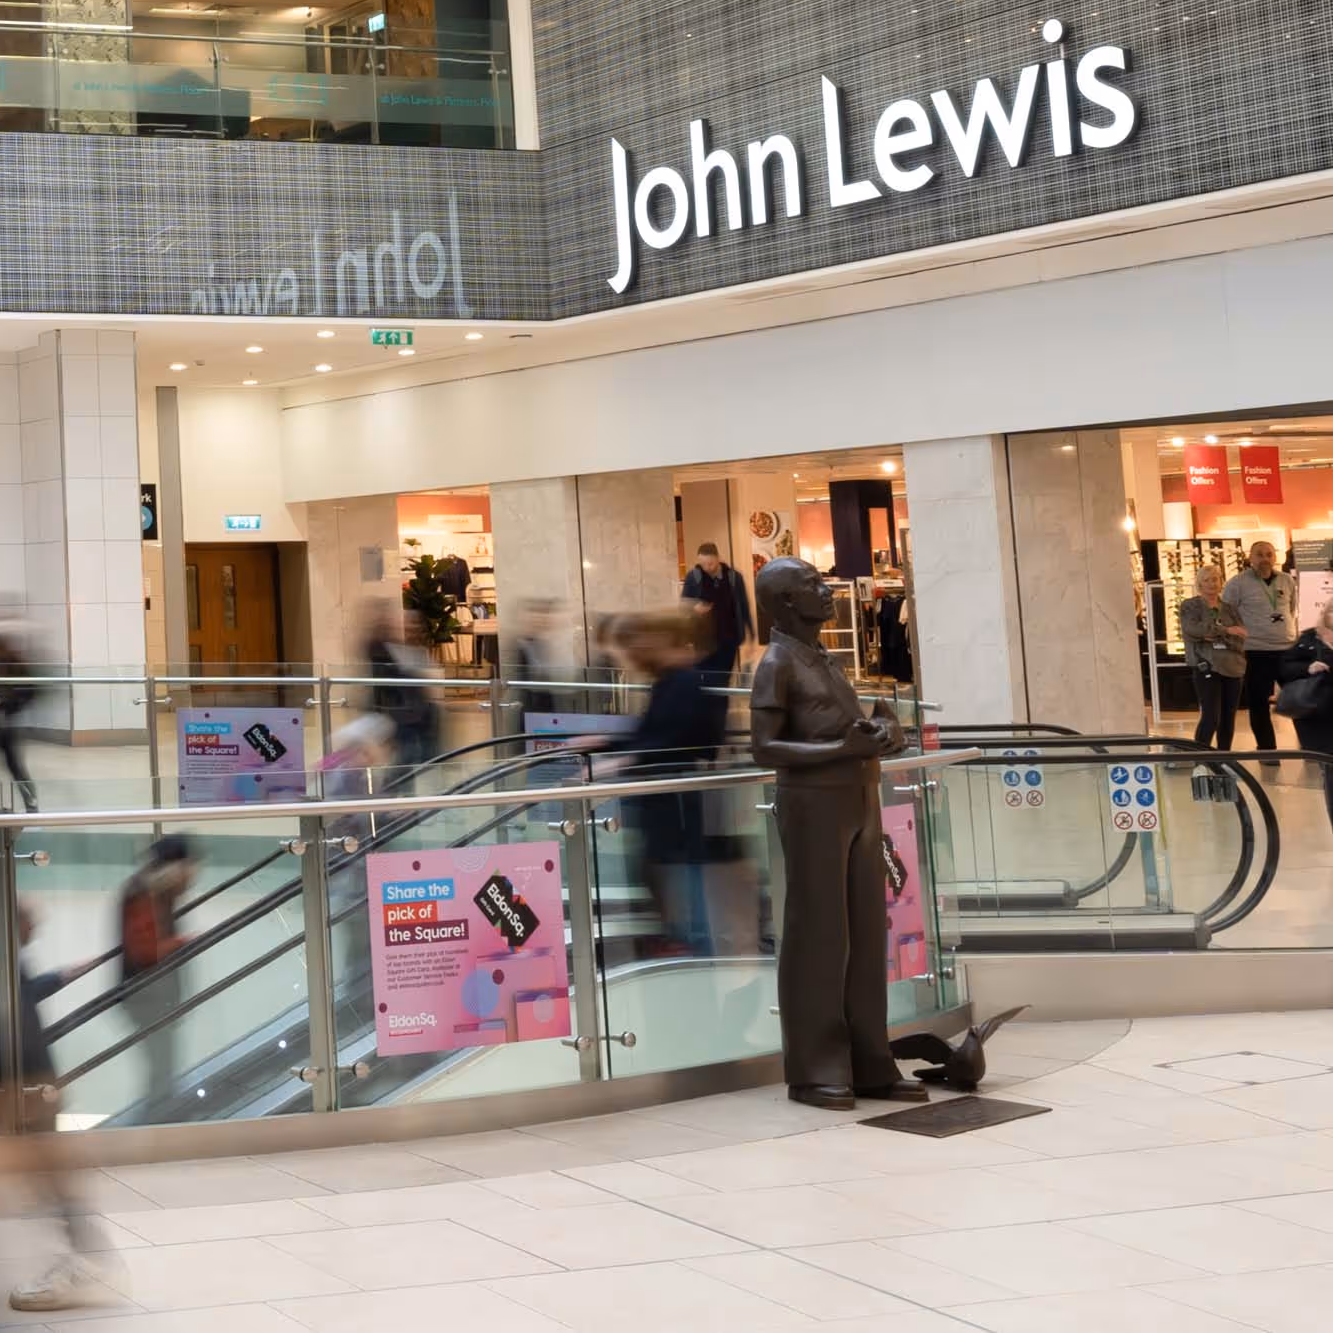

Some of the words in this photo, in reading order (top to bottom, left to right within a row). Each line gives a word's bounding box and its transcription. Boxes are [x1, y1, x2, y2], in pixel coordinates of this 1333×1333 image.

[606, 119, 804, 295] John
[820, 17, 1138, 208] Lewis
[1189, 466, 1220, 475] Fashion
[1244, 465, 1272, 475] Fashion
[1191, 476, 1215, 485] Offers
[1245, 476, 1268, 485] Offers
[188, 735, 206, 745] pick
[207, 735, 217, 743] of
[188, 746, 203, 754] the
[204, 746, 237, 756] Square!
[387, 885, 425, 900] Share
[428, 883, 450, 897] the
[387, 908, 415, 924] pick
[418, 904, 433, 919] of
[486, 883, 525, 938] EldonSq.
[389, 928, 411, 942] the
[414, 923, 465, 942] Square!
[388, 1012, 438, 1027] EldonSq.
